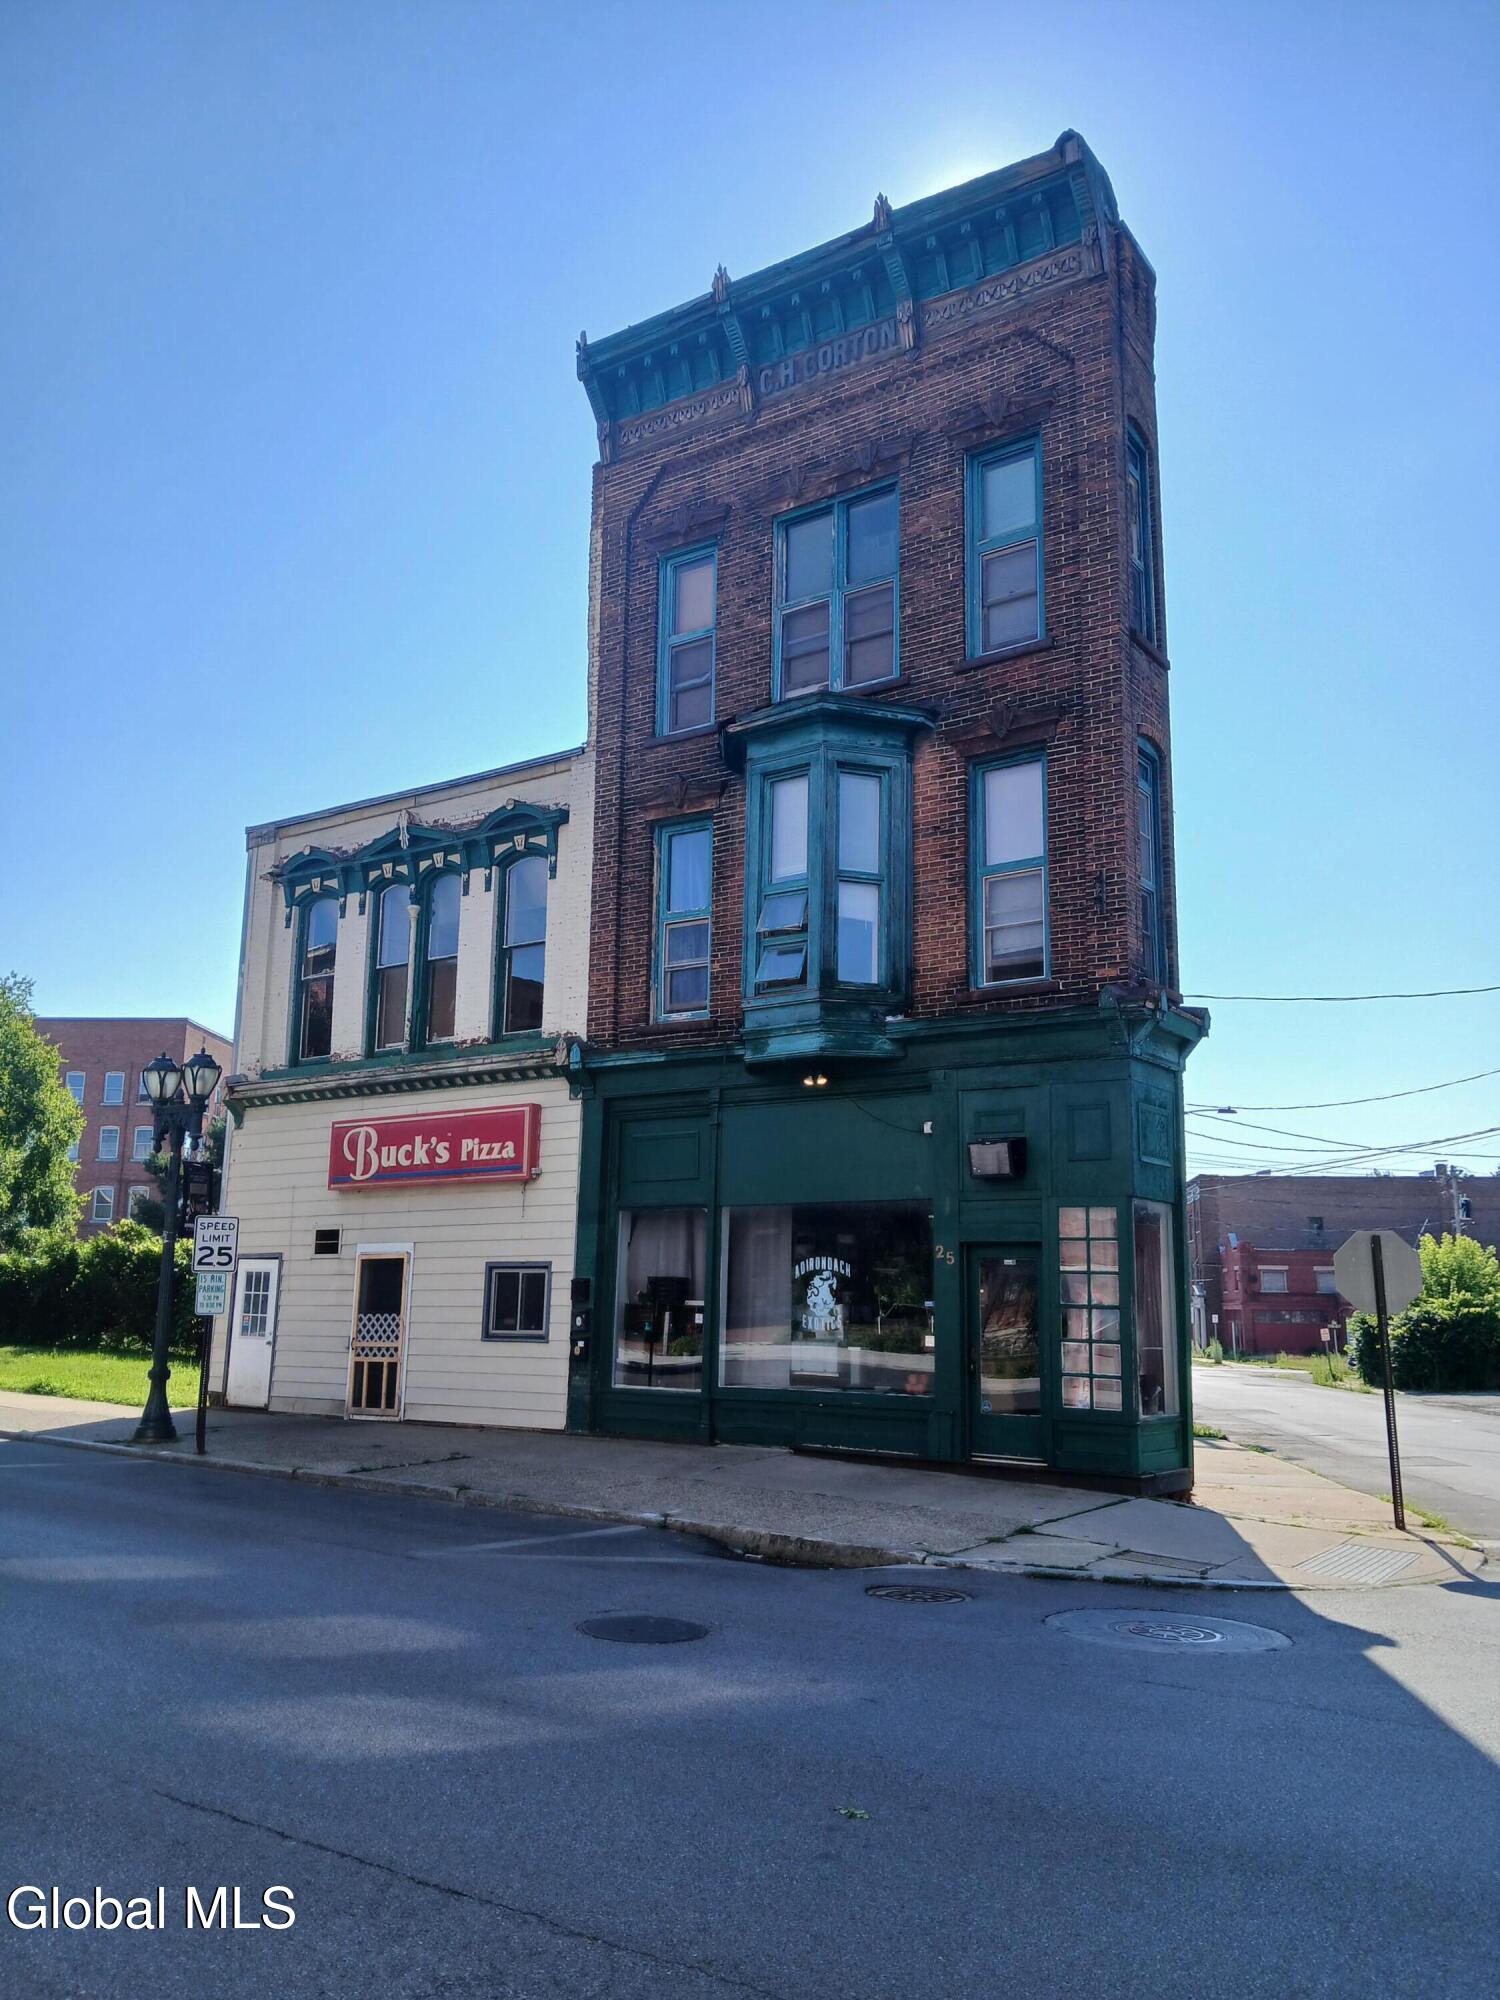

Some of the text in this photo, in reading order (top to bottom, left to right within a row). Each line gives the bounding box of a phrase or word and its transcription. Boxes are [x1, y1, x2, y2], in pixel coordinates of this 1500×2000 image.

[343, 1125, 516, 1181] Buck's Pizza
[200, 1222, 235, 1230] SPEED
[202, 1234, 230, 1242] LIMIT
[197, 1246, 233, 1266] 25
[935, 1245, 955, 1265] 25
[200, 1274, 208, 1284] 15
[199, 1285, 225, 1294] PARKING
